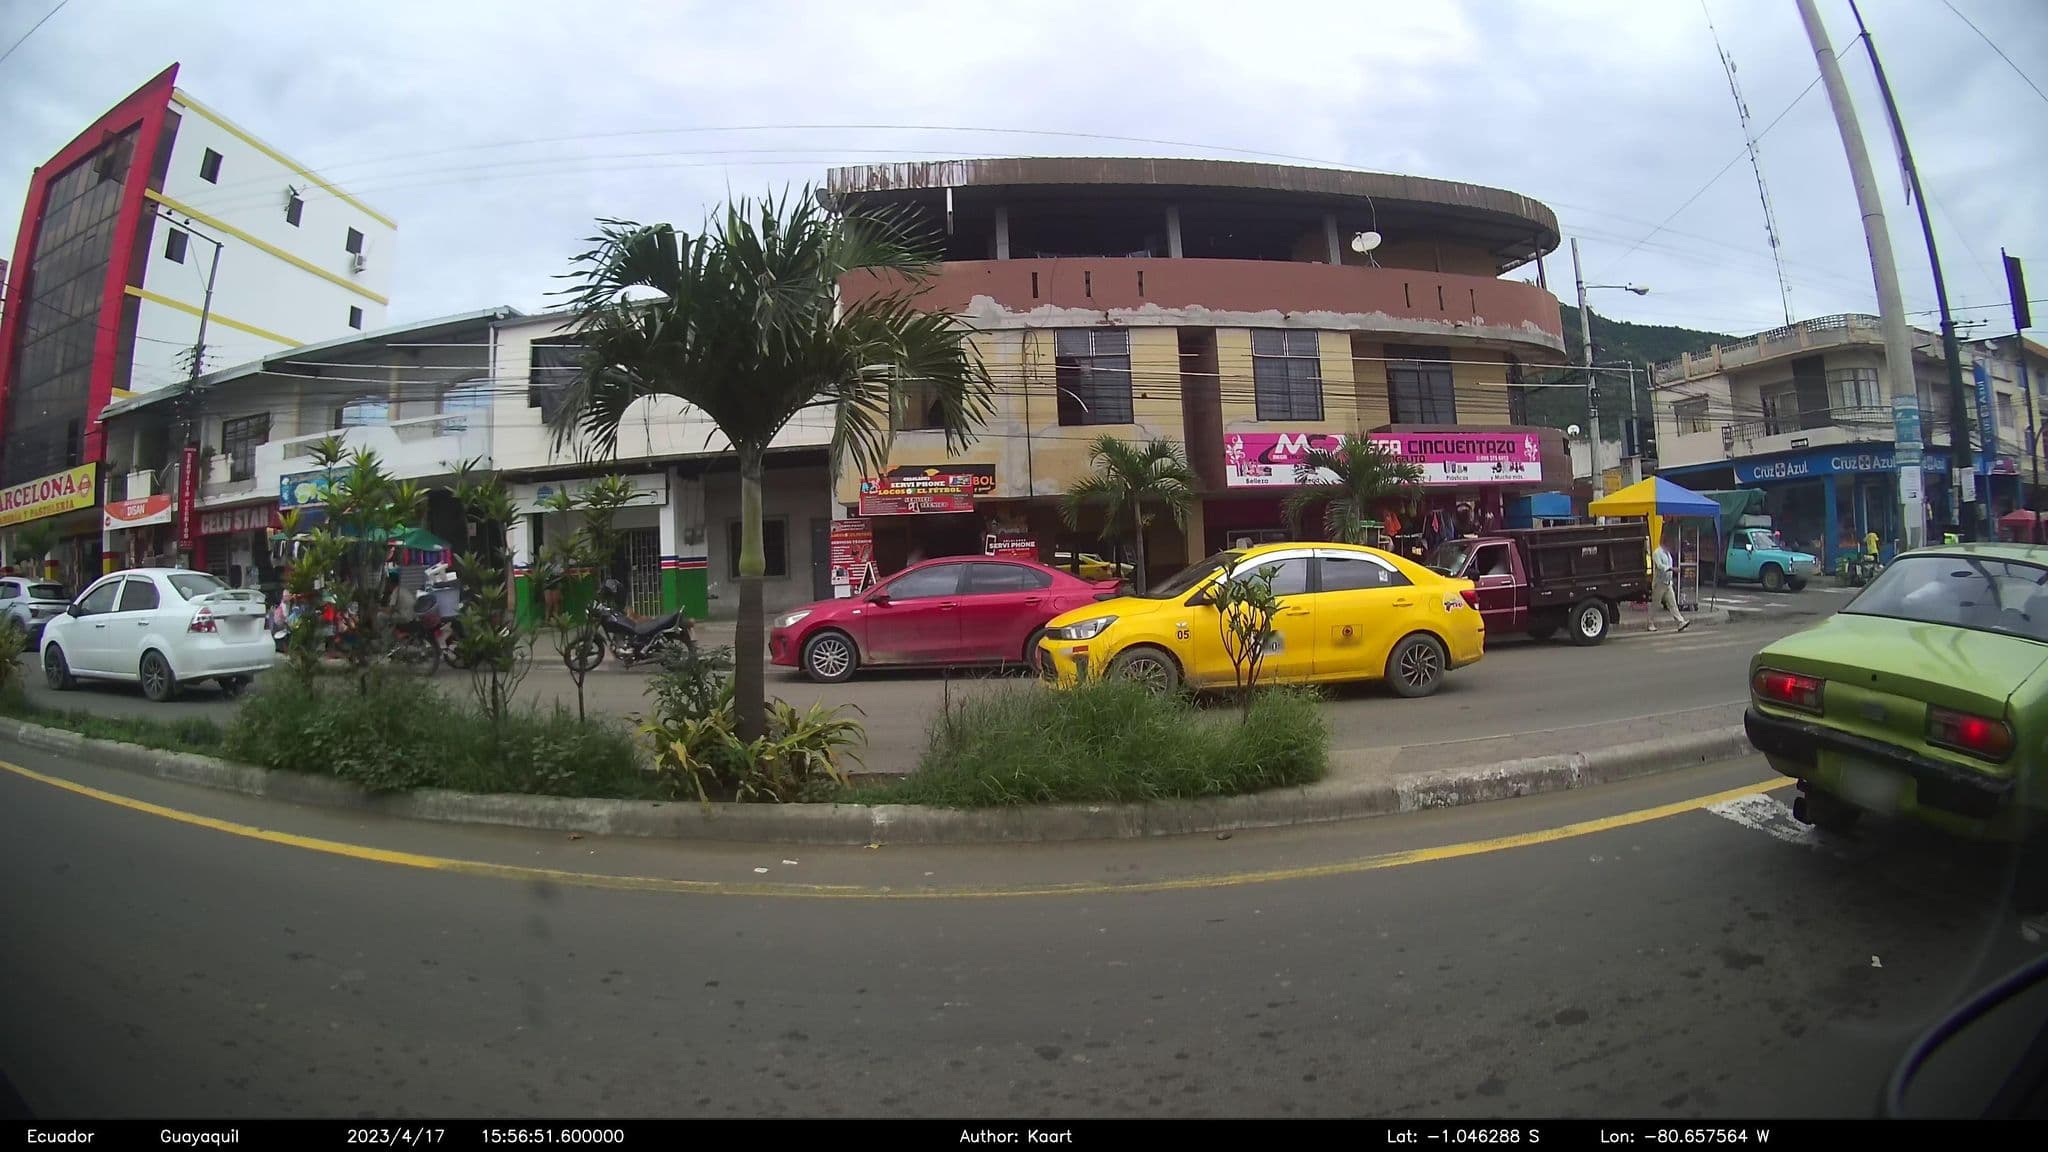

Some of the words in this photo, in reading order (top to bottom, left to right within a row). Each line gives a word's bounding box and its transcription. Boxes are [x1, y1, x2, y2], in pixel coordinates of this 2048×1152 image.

[1407, 439, 1517, 455] CINCUENTAZO
[1753, 466, 1775, 479] Cruz
[1786, 460, 1808, 476] Azul
[1831, 457, 1858, 470] Cruz
[916, 480, 946, 488] PHONE
[1177, 630, 1190, 640] 05
